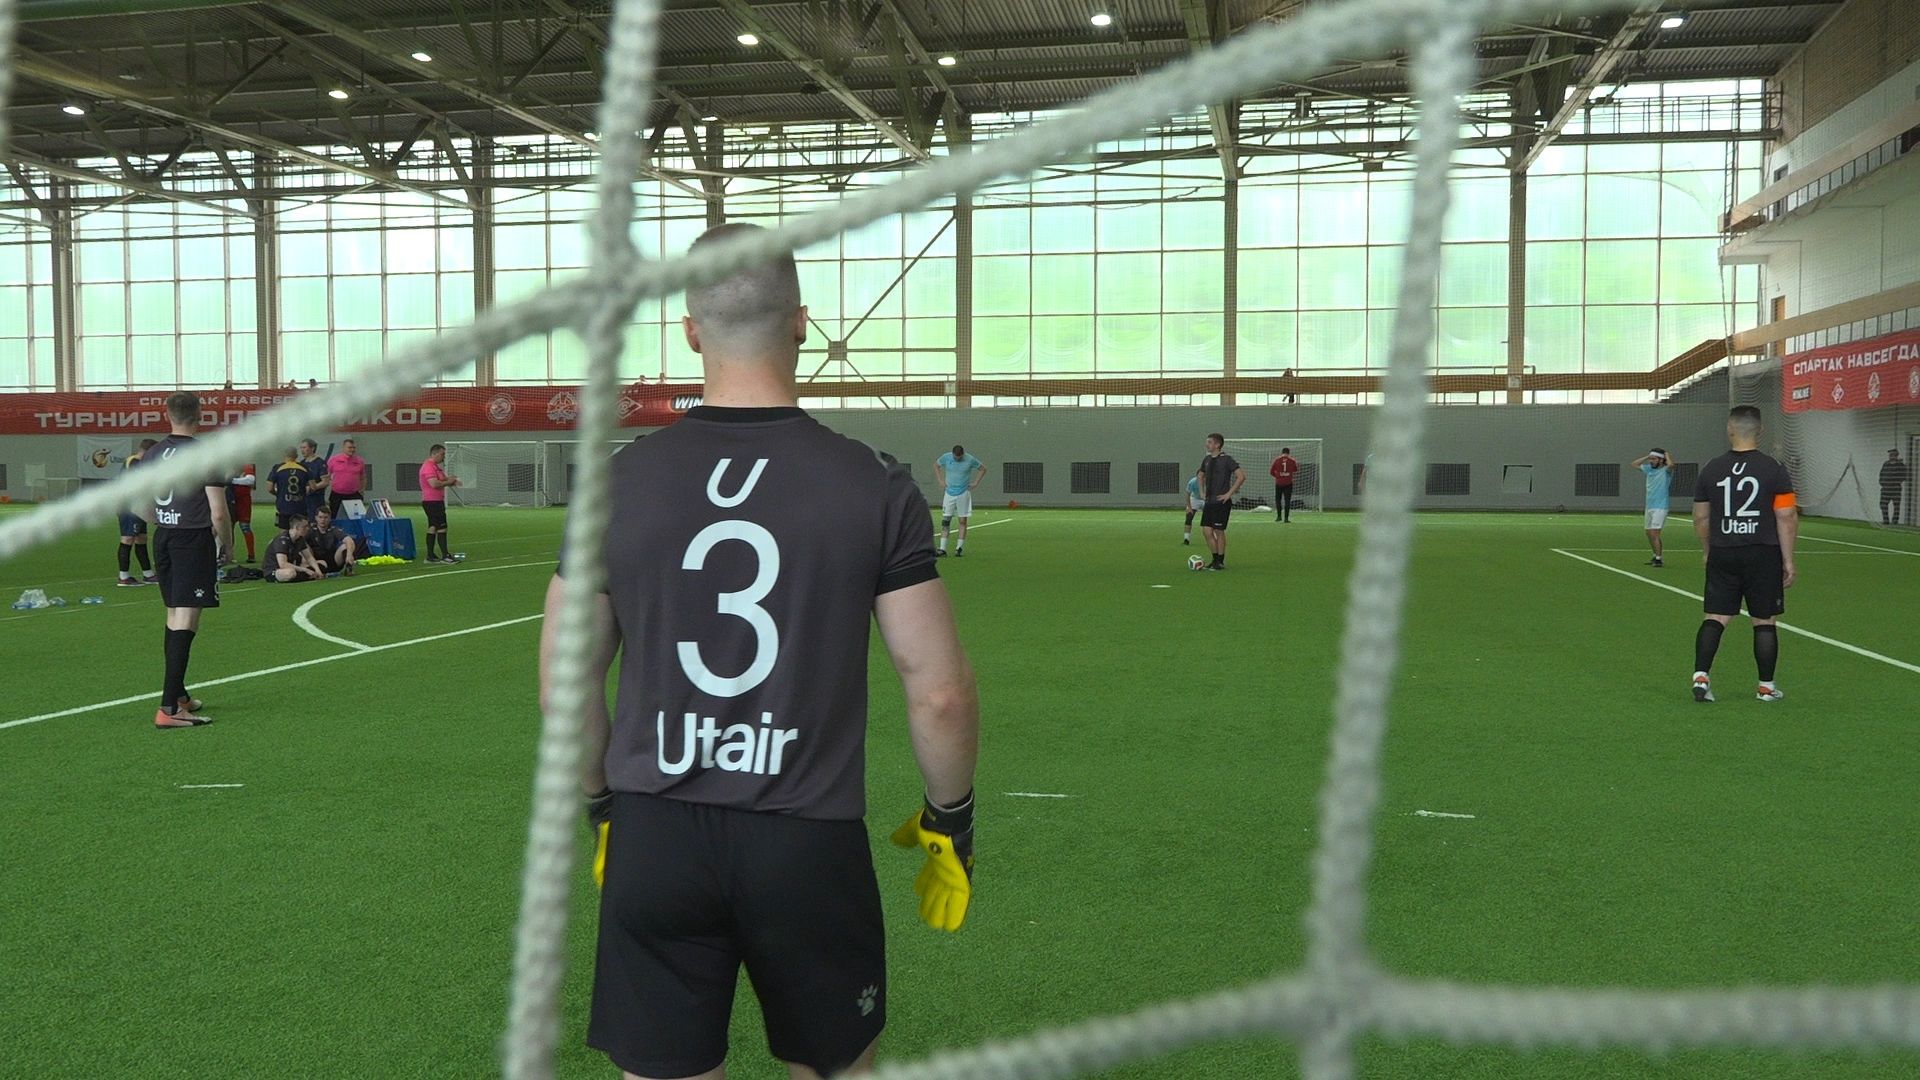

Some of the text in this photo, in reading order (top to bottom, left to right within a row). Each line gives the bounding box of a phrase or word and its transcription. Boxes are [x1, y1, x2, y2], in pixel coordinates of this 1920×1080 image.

[1793, 344, 1920, 376] СПАРТАК НАВСЕГДА
[34, 411, 162, 428] ТУРНИР
[1731, 462, 1747, 475] U
[287, 475, 300, 494] 8
[706, 458, 769, 508] U
[1716, 476, 1761, 517] 12
[155, 508, 182, 525] tair
[1721, 519, 1758, 534] Utair
[676, 519, 781, 698] 3
[657, 711, 799, 776] Utair
